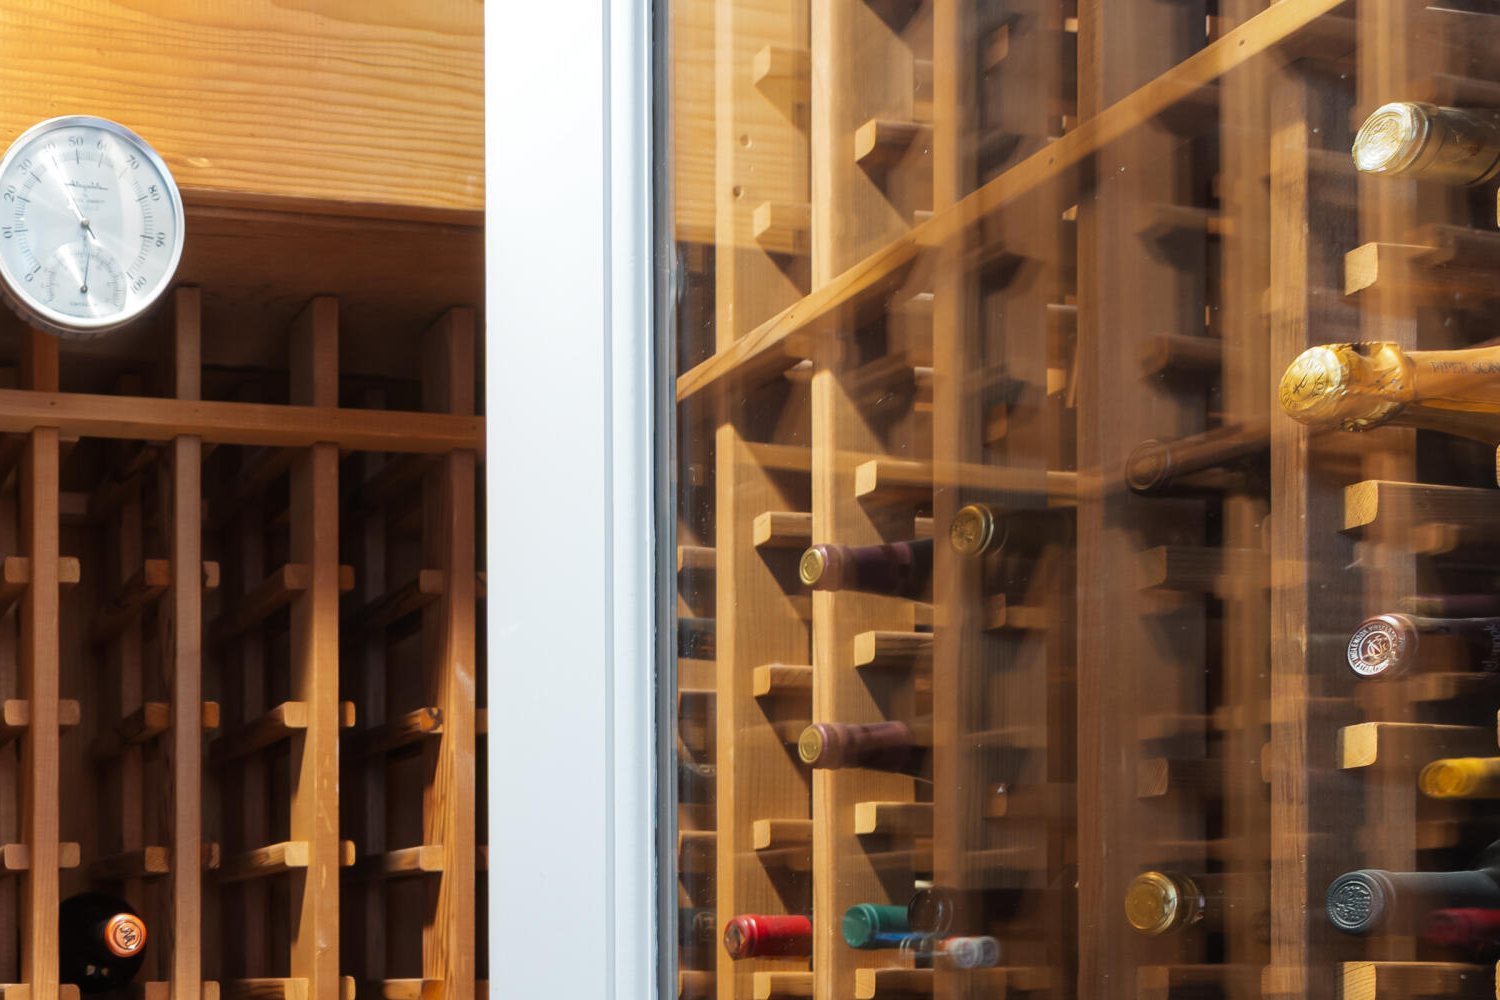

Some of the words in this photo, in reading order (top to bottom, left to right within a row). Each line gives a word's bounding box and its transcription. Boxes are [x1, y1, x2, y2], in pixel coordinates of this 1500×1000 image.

[68, 136, 84, 148] 50
[17, 158, 33, 174] 30
[125, 155, 141, 171] 70
[3, 185, 17, 203] 20
[148, 185, 161, 202] 80
[3, 226, 13, 239] 10
[155, 232, 167, 248] 90
[131, 276, 148, 295] 100
